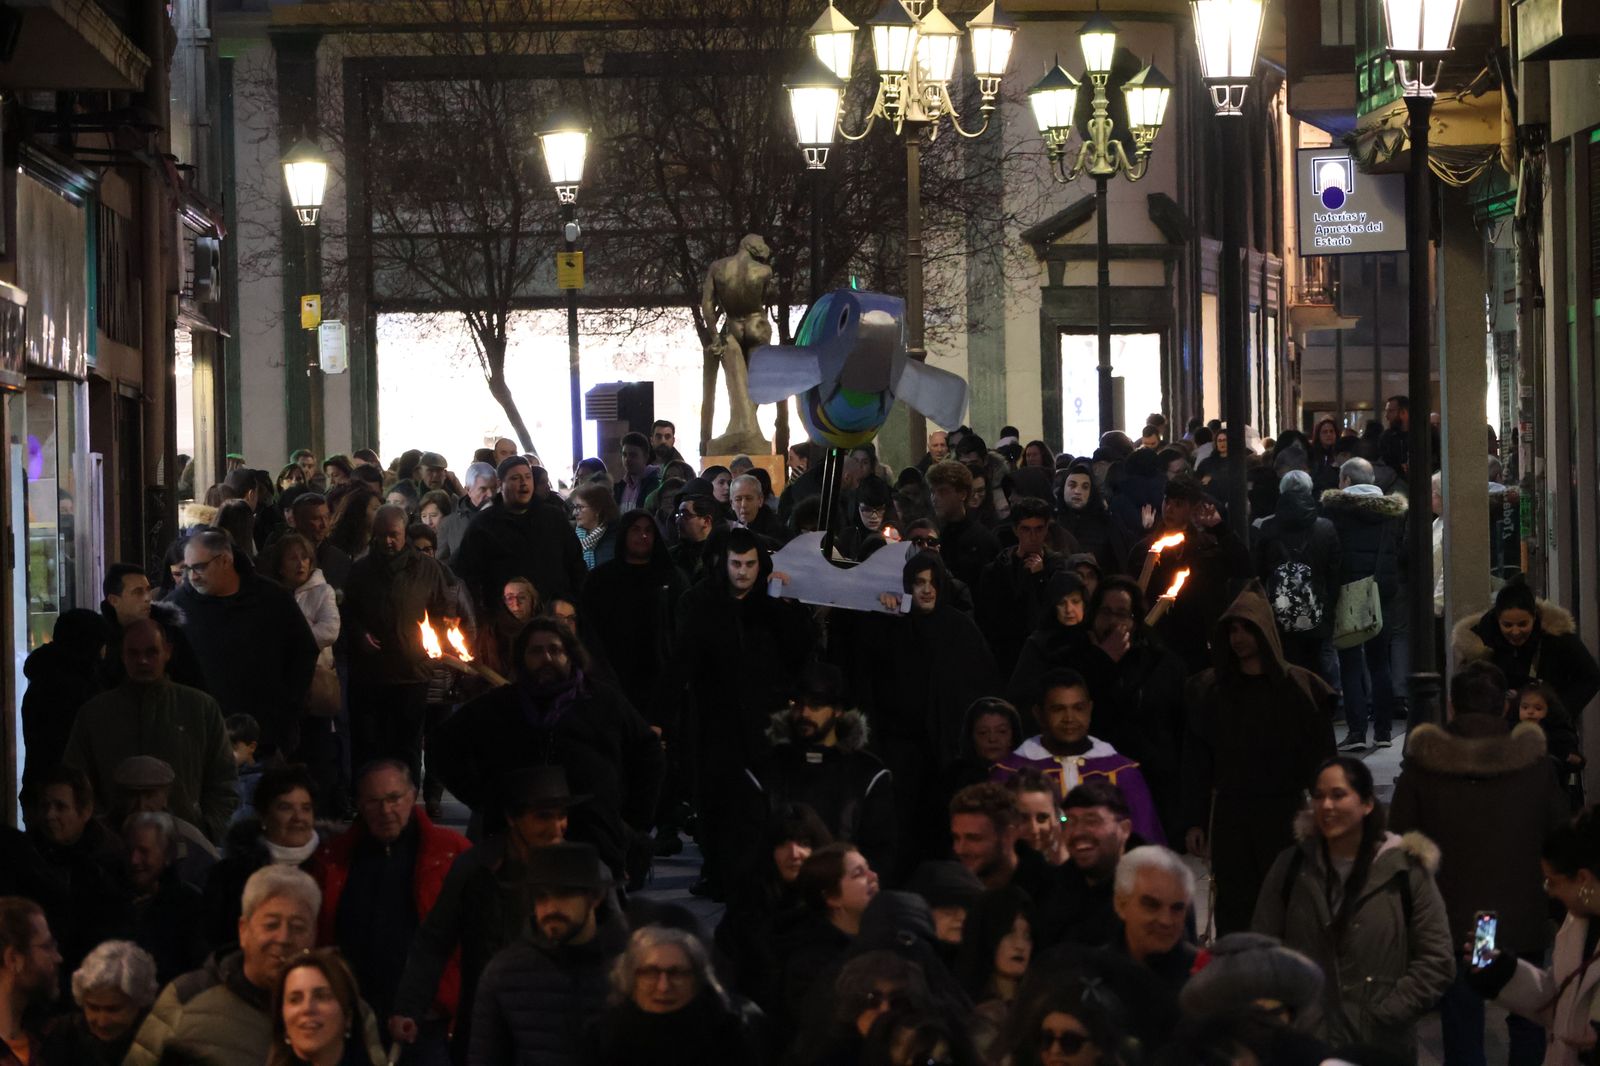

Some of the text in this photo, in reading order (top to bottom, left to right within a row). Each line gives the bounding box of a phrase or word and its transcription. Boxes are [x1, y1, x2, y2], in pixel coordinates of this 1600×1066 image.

[1314, 211, 1367, 223] Loterías y
[1315, 221, 1383, 236] Apuestas del
[1315, 235, 1352, 247] Estado
